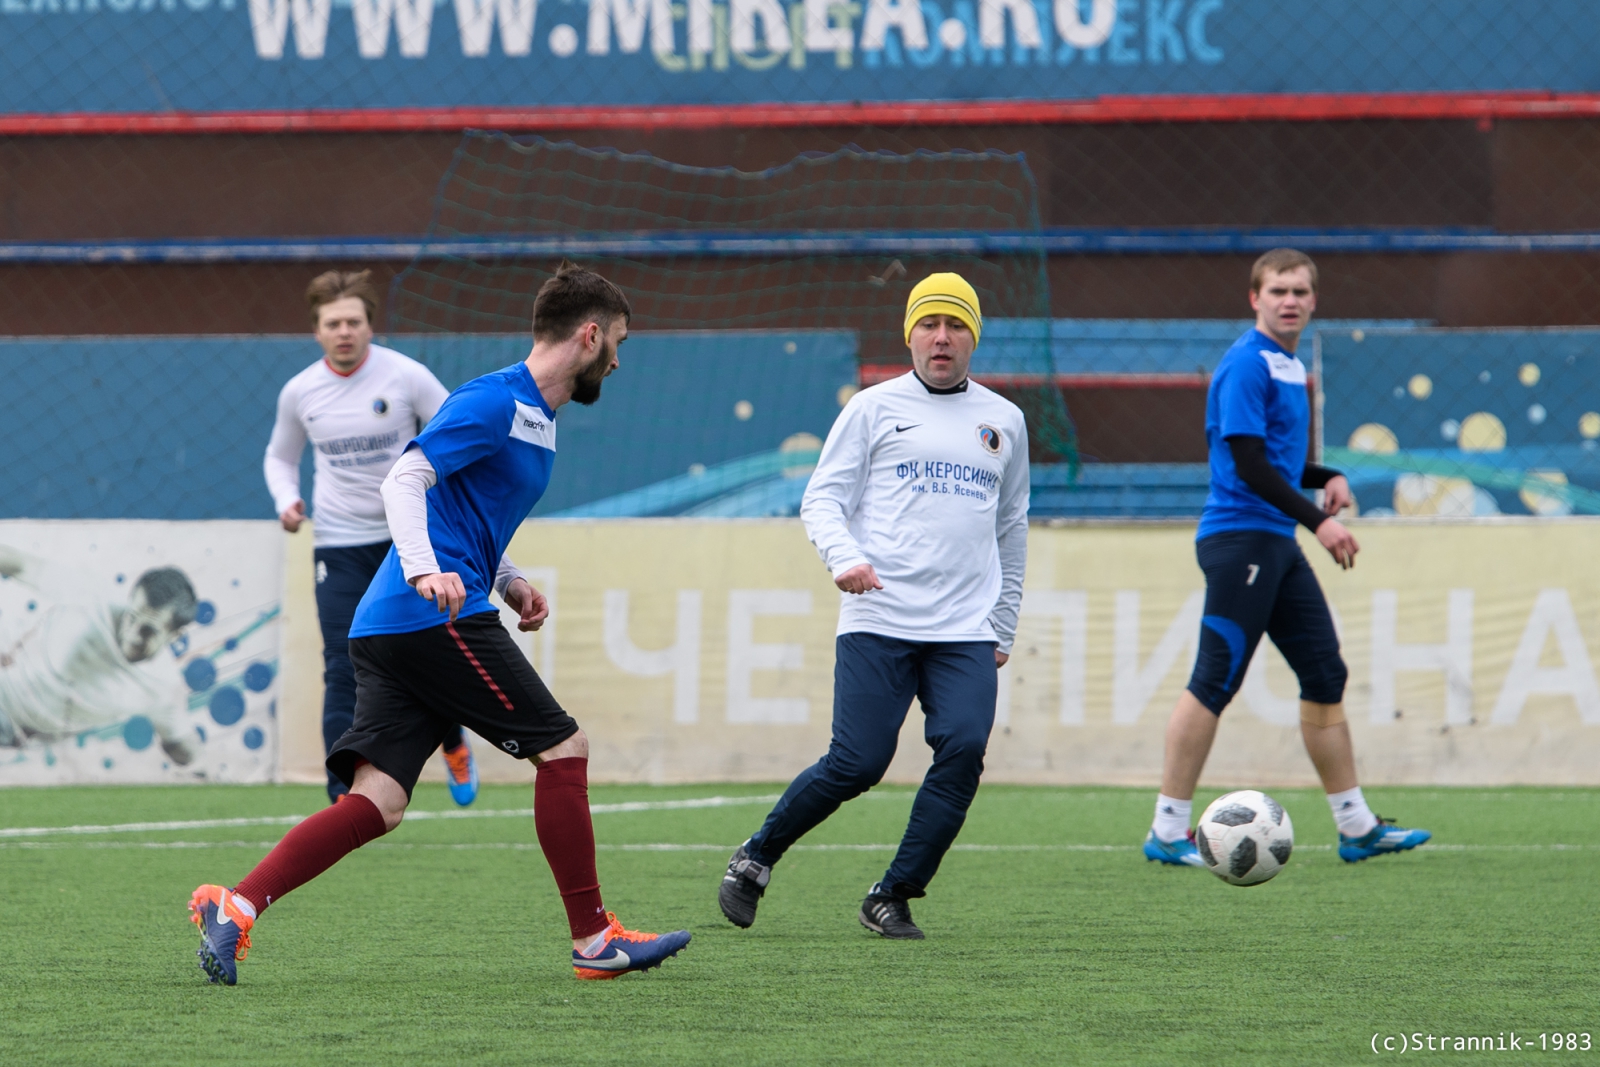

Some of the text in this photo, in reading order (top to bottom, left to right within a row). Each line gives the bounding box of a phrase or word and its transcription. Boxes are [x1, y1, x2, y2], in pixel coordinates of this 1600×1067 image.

[896, 461, 919, 479] ФК
[911, 482, 987, 501] им. В.Б. Ясенева
[1247, 564, 1260, 586] 7
[604, 588, 1600, 727] ЧЕПИНА
